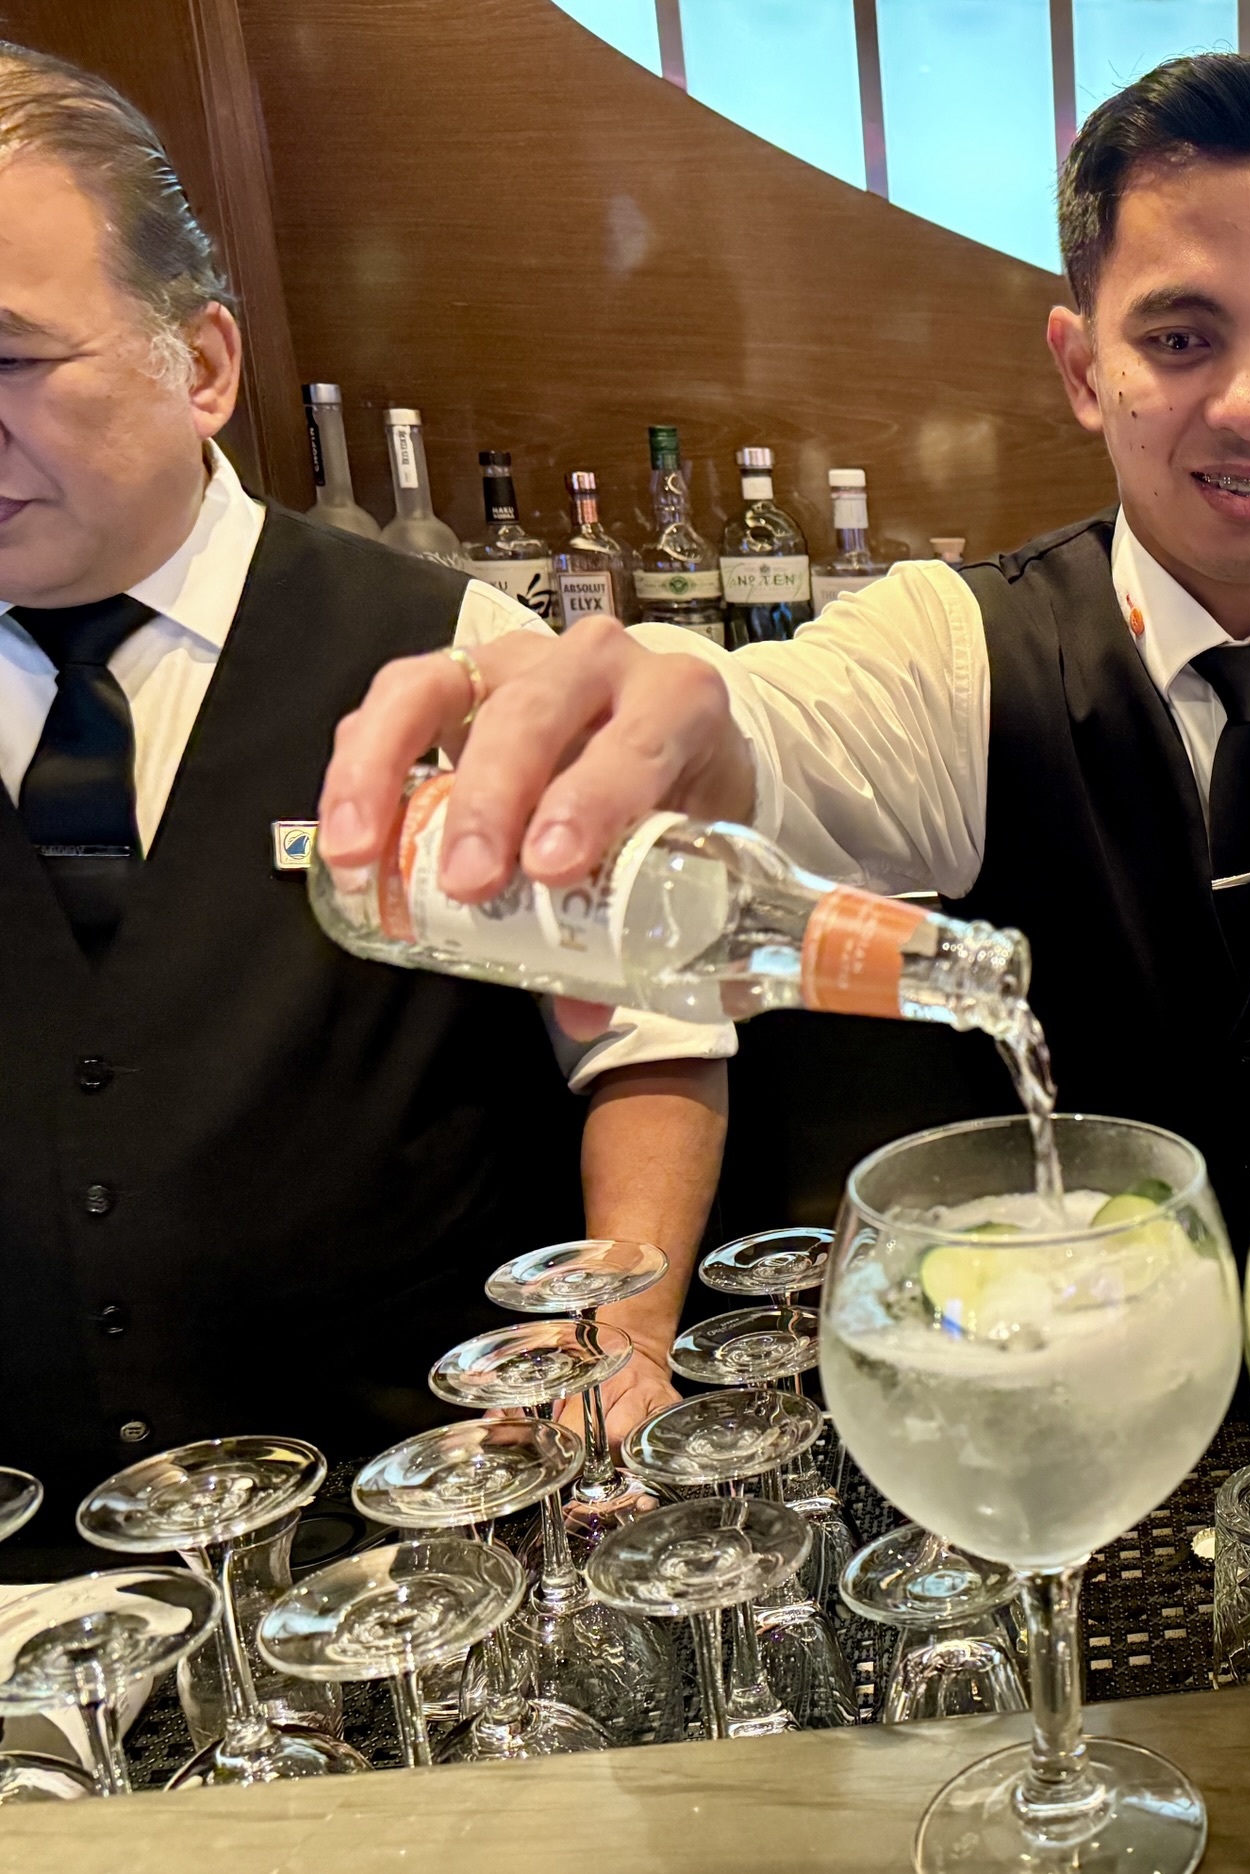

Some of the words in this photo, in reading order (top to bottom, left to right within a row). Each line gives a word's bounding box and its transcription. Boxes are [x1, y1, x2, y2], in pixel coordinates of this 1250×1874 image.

[491, 506, 515, 515] HAKU
[760, 574, 796, 587] TEN
[563, 583, 607, 594] ABSOLUT
[569, 598, 604, 612] ELYX
